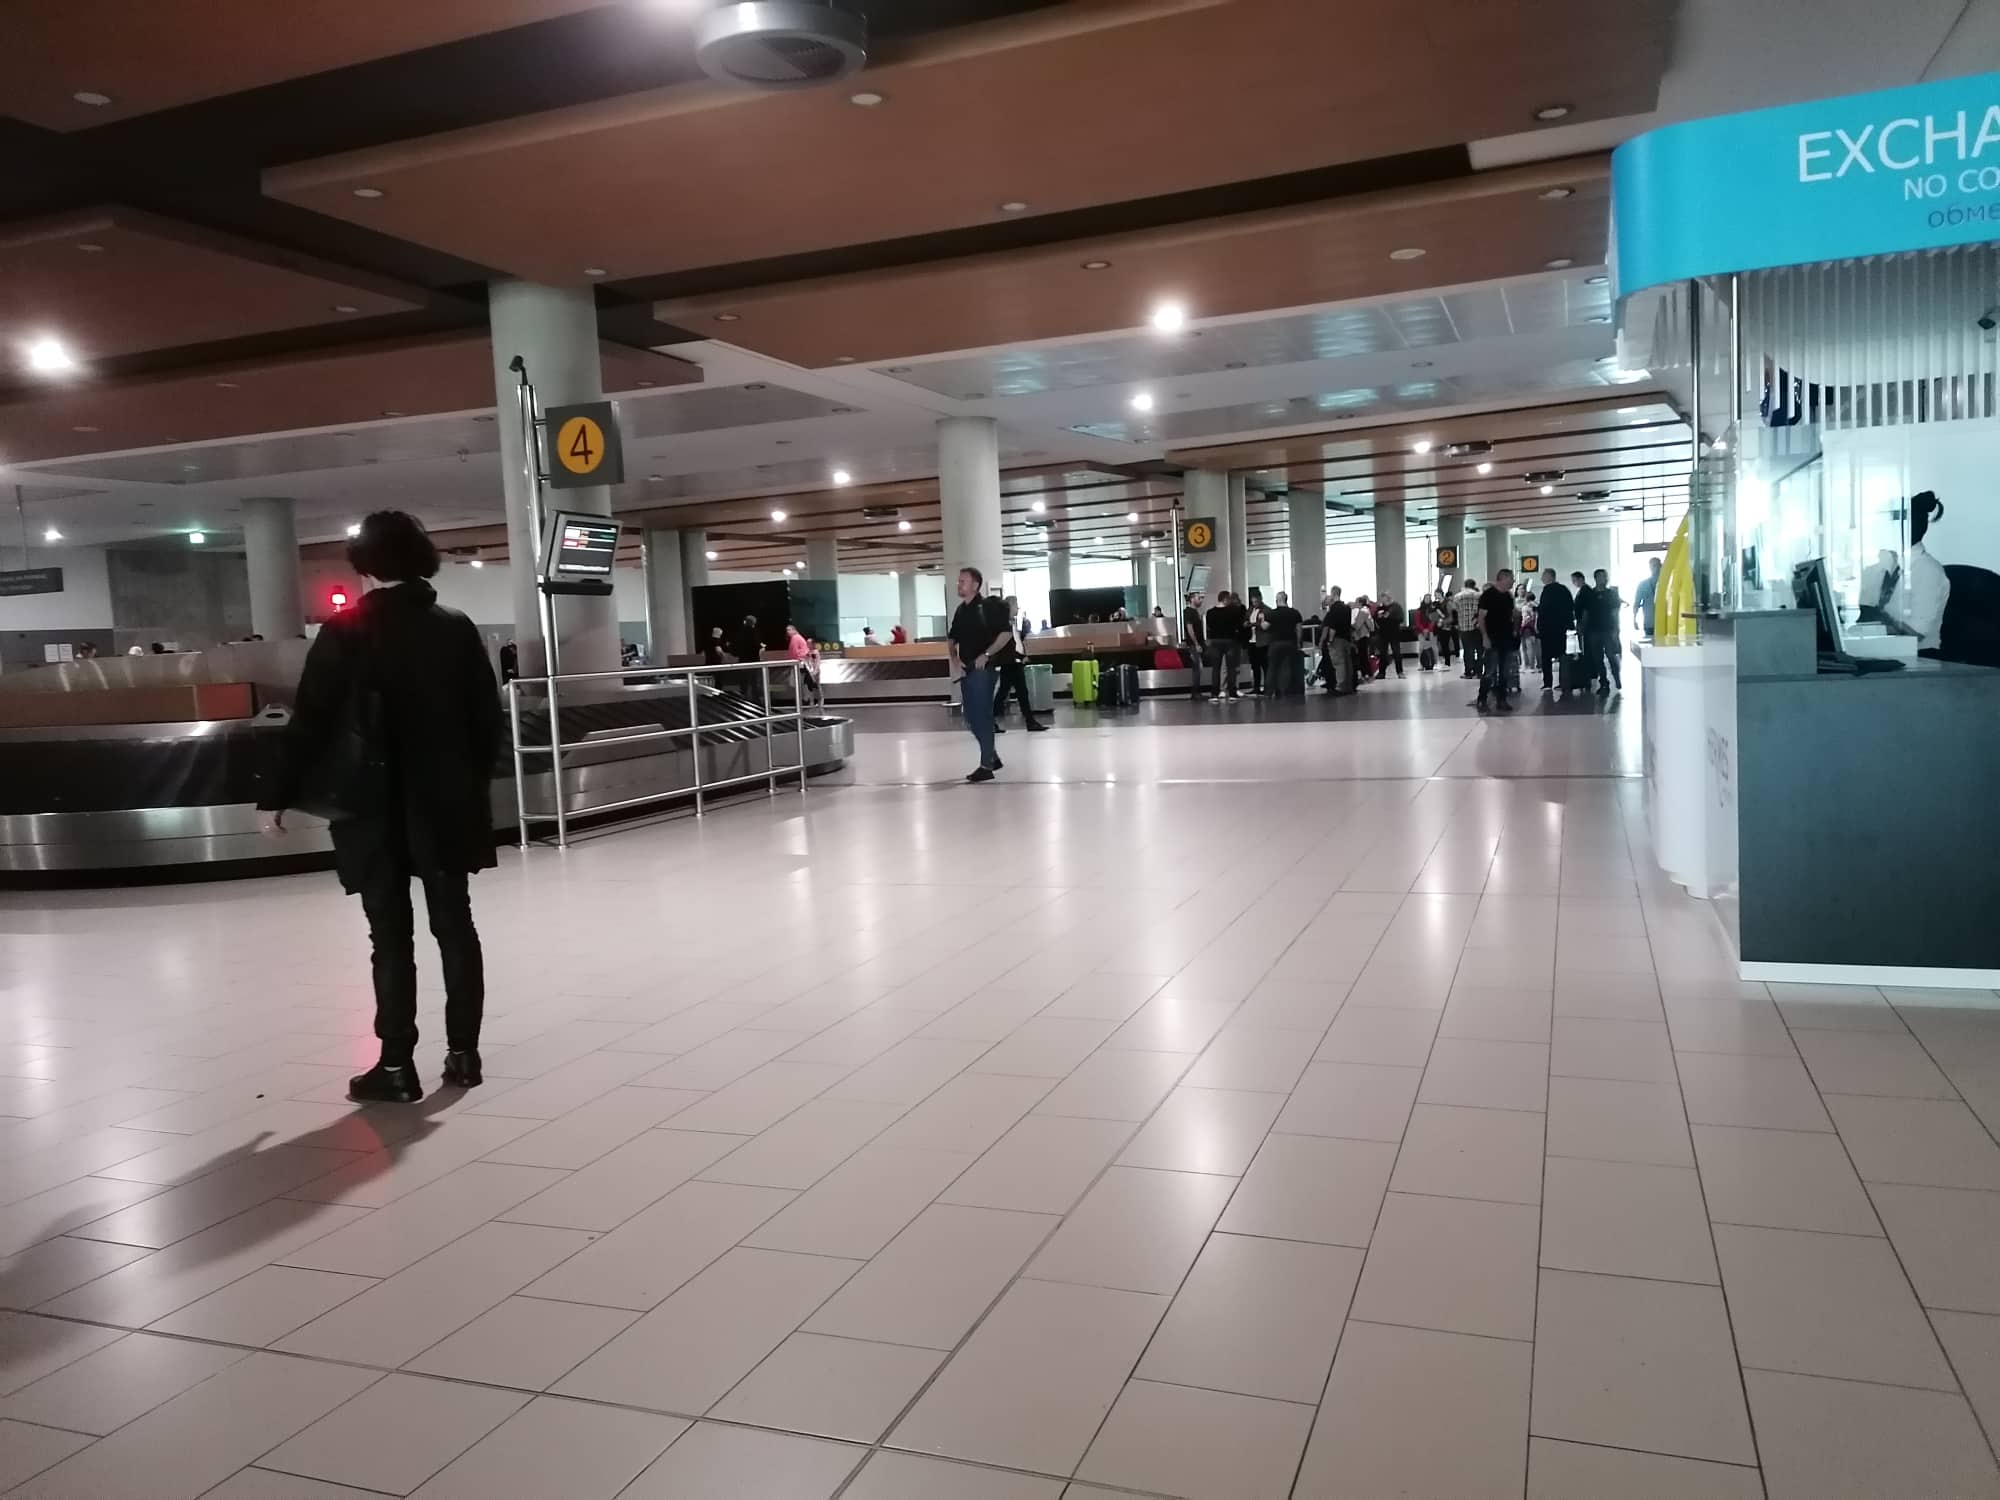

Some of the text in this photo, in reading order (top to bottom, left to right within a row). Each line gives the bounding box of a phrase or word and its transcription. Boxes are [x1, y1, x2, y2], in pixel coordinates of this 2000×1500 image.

[1798, 104, 2000, 183] EXCHA
[1904, 166, 2000, 201] NO CO
[570, 423, 594, 465] 4
[1193, 526, 1206, 545] 3
[1442, 551, 1452, 564] 2
